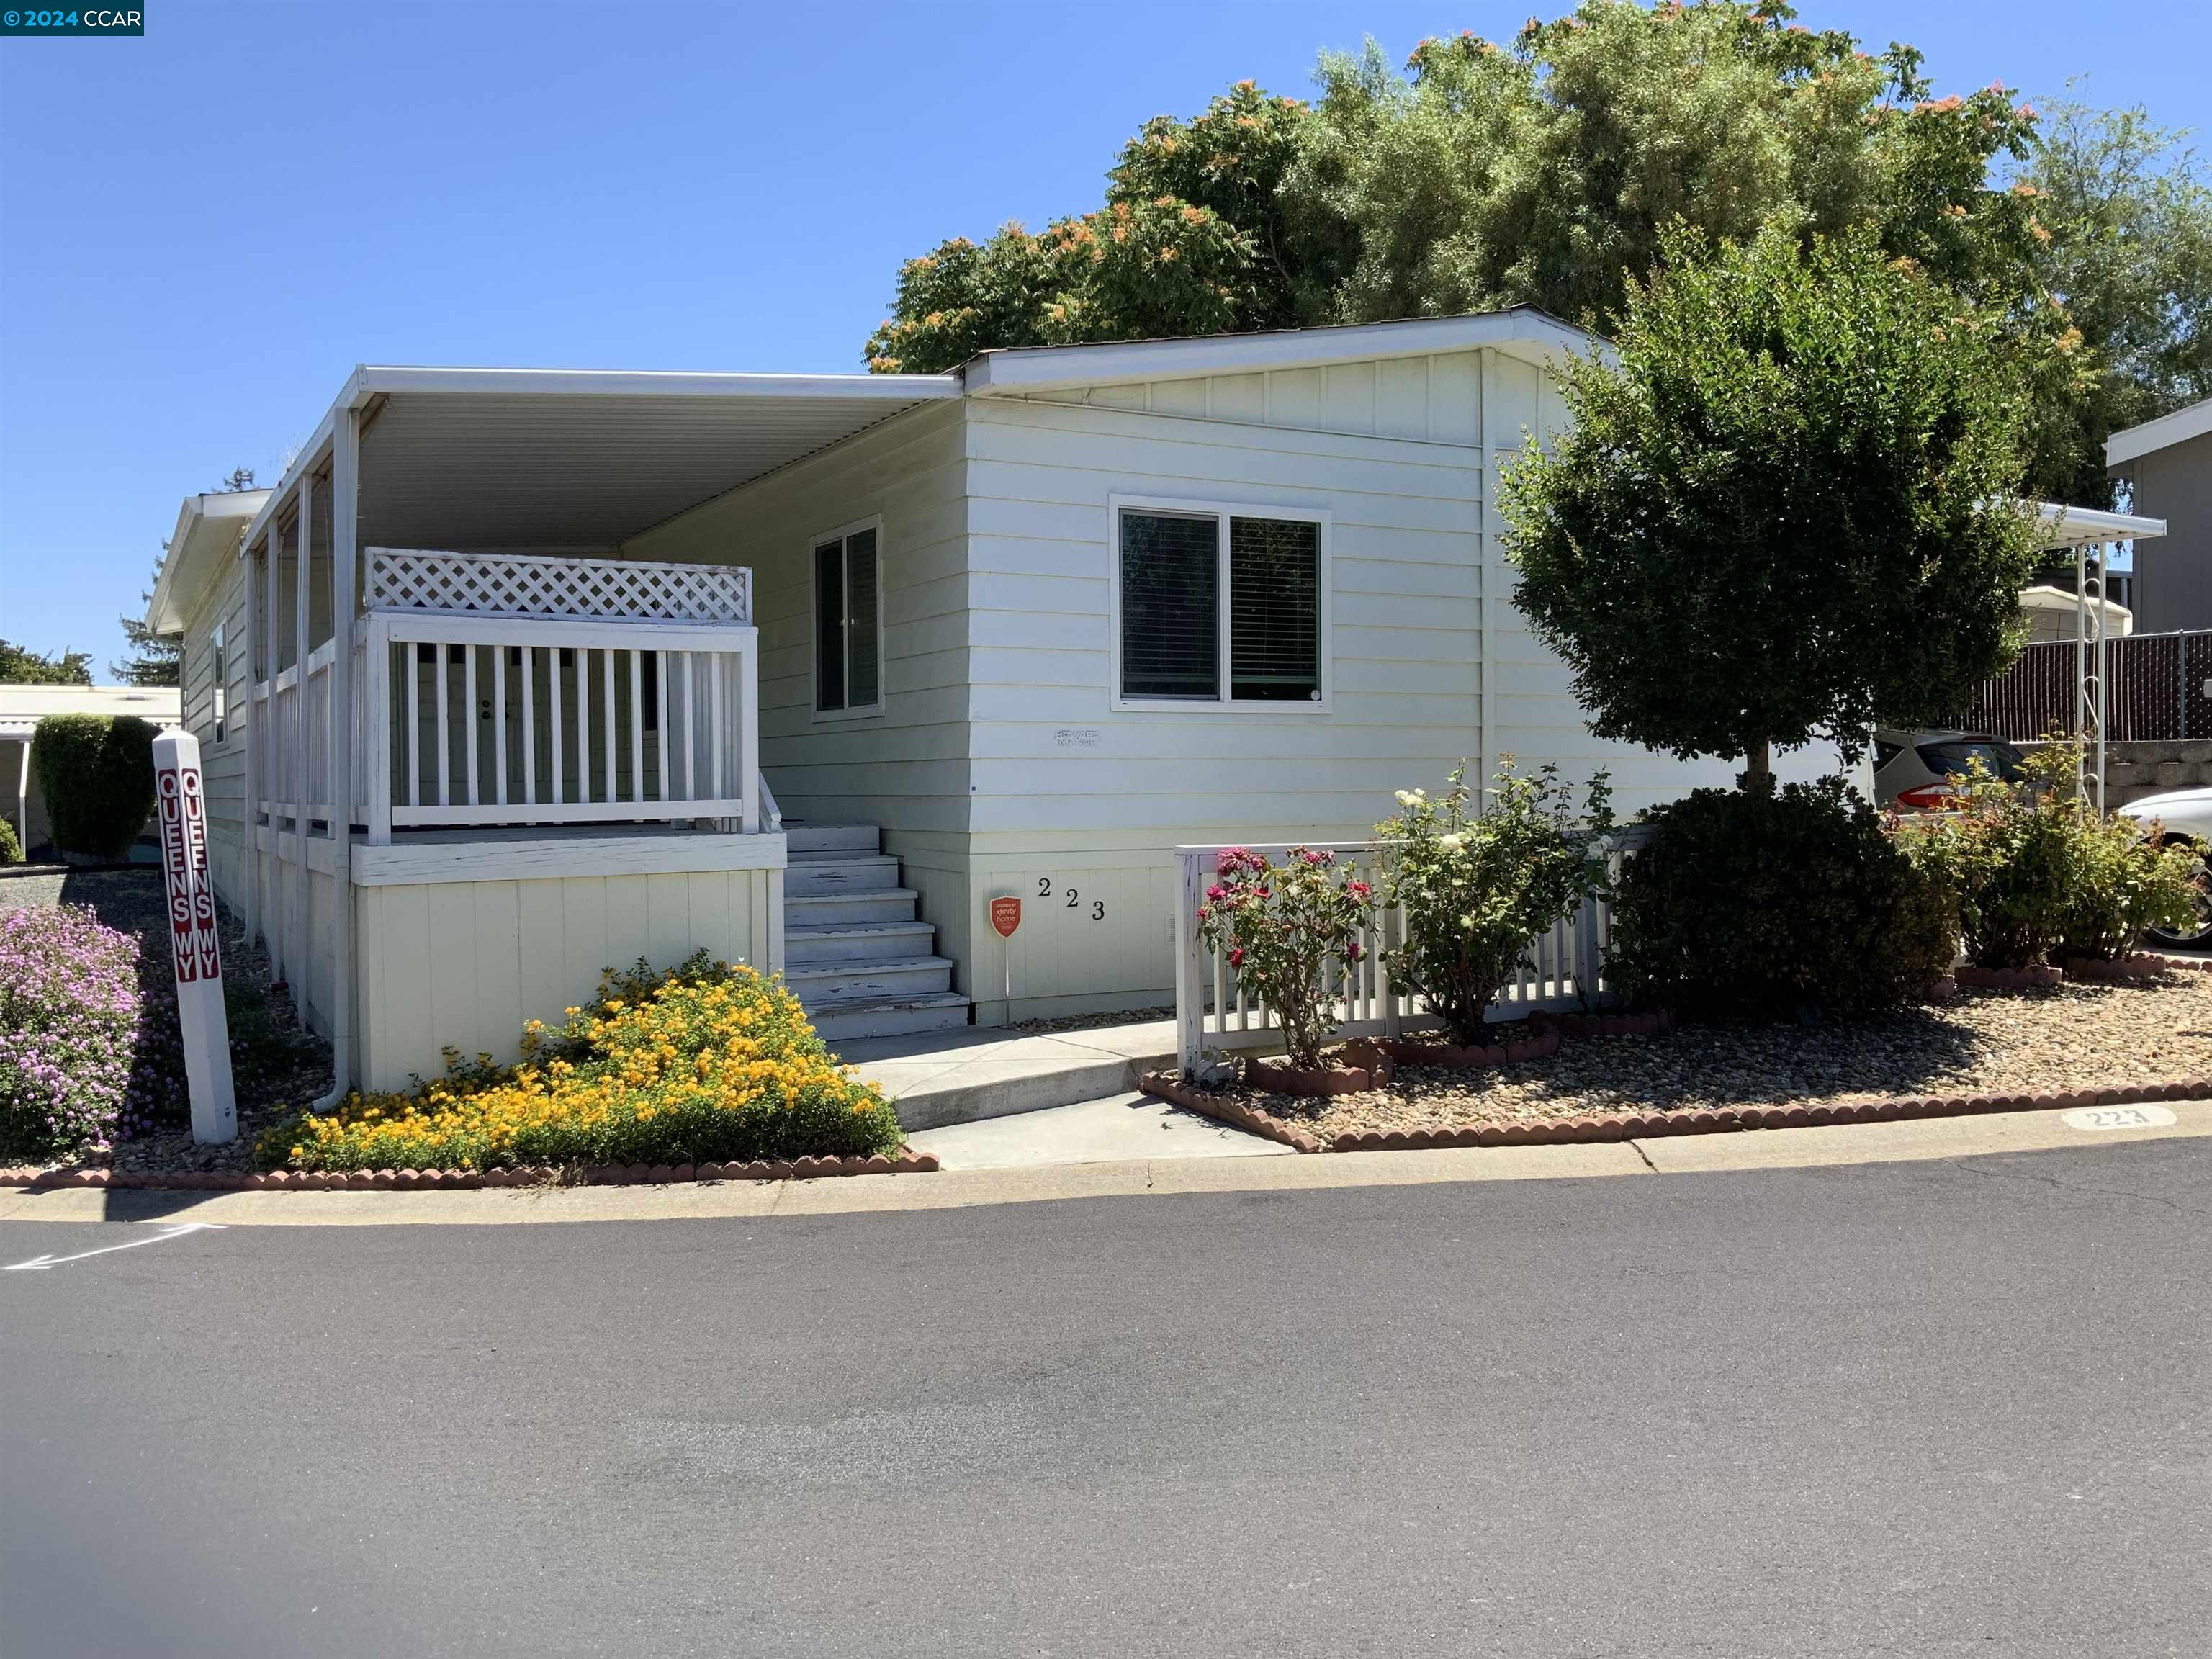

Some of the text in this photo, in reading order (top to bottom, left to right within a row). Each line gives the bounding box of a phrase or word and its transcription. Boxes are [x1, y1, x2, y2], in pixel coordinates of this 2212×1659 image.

[160, 773, 194, 979] QUEENS WY
[183, 771, 215, 976] QUEENS WY
[1038, 878, 1105, 920] 223
[2085, 1110, 2149, 1126] 223
